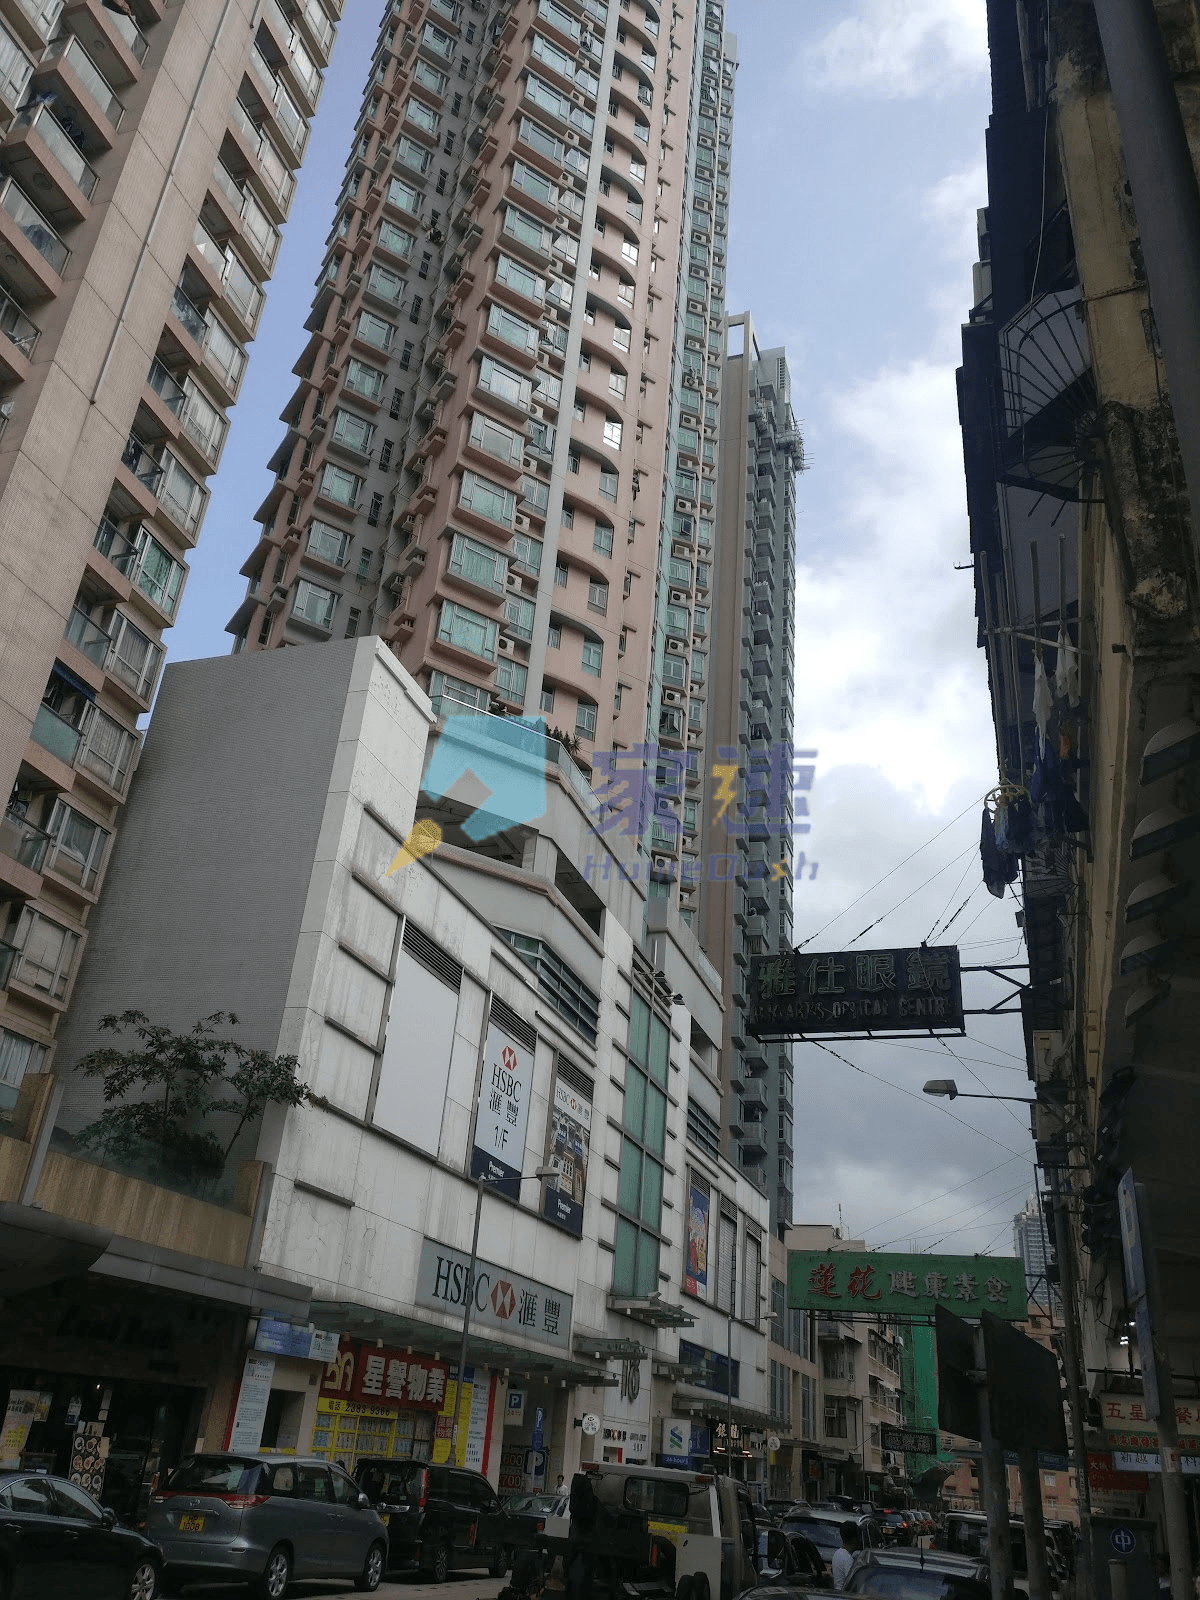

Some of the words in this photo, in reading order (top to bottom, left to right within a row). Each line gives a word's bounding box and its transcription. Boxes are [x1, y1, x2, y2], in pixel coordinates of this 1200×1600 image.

[757, 951, 953, 999] 雅仕眼鏡
[491, 1062, 522, 1103] HSBC
[494, 1125, 509, 1150] 1/F
[488, 1160, 505, 1178] Premier
[557, 1198, 572, 1215] Premier
[808, 1262, 882, 1301] 蓮花
[887, 1269, 1012, 1304] 健康素食
[345, 1401, 367, 1414] 2383
